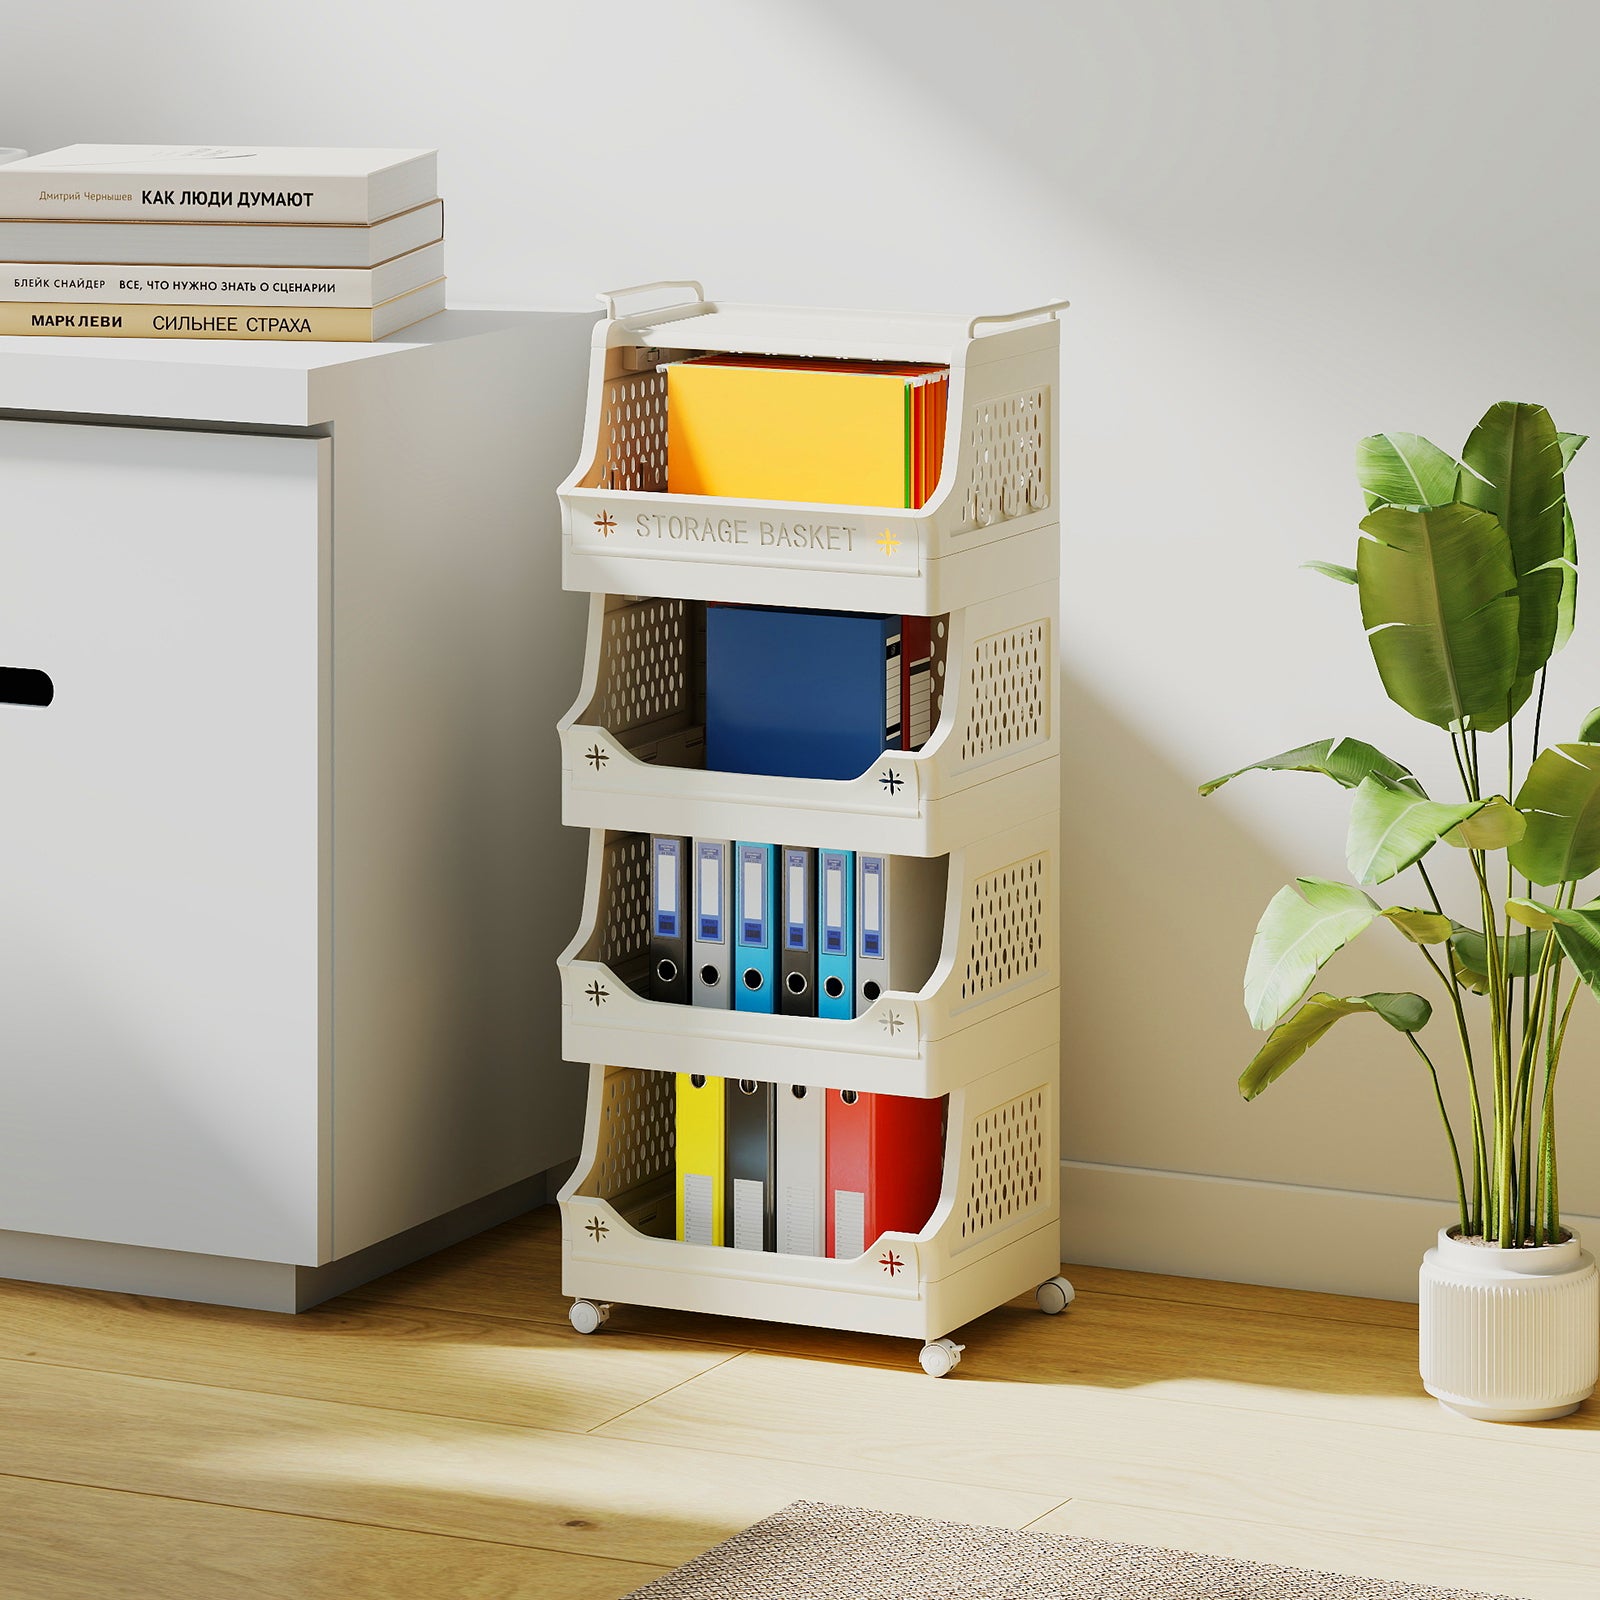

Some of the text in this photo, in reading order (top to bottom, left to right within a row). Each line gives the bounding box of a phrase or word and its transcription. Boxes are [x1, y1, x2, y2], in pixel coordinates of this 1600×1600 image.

[39, 190, 314, 208] Дмитрий Чернышев КАК ЛЮДИ ДУМАЮТ
[14, 277, 336, 294] БЛЕЙК СНАЙДЕР ВСЕ, ЧТО НУЖНО ЗНАТЬ О СЦЕНАРИИ
[31, 315, 311, 333] МАРК ЛЕВИ СИЛЬНЕЕ СТРАХА
[636, 512, 857, 552] STORAGE BASKET
